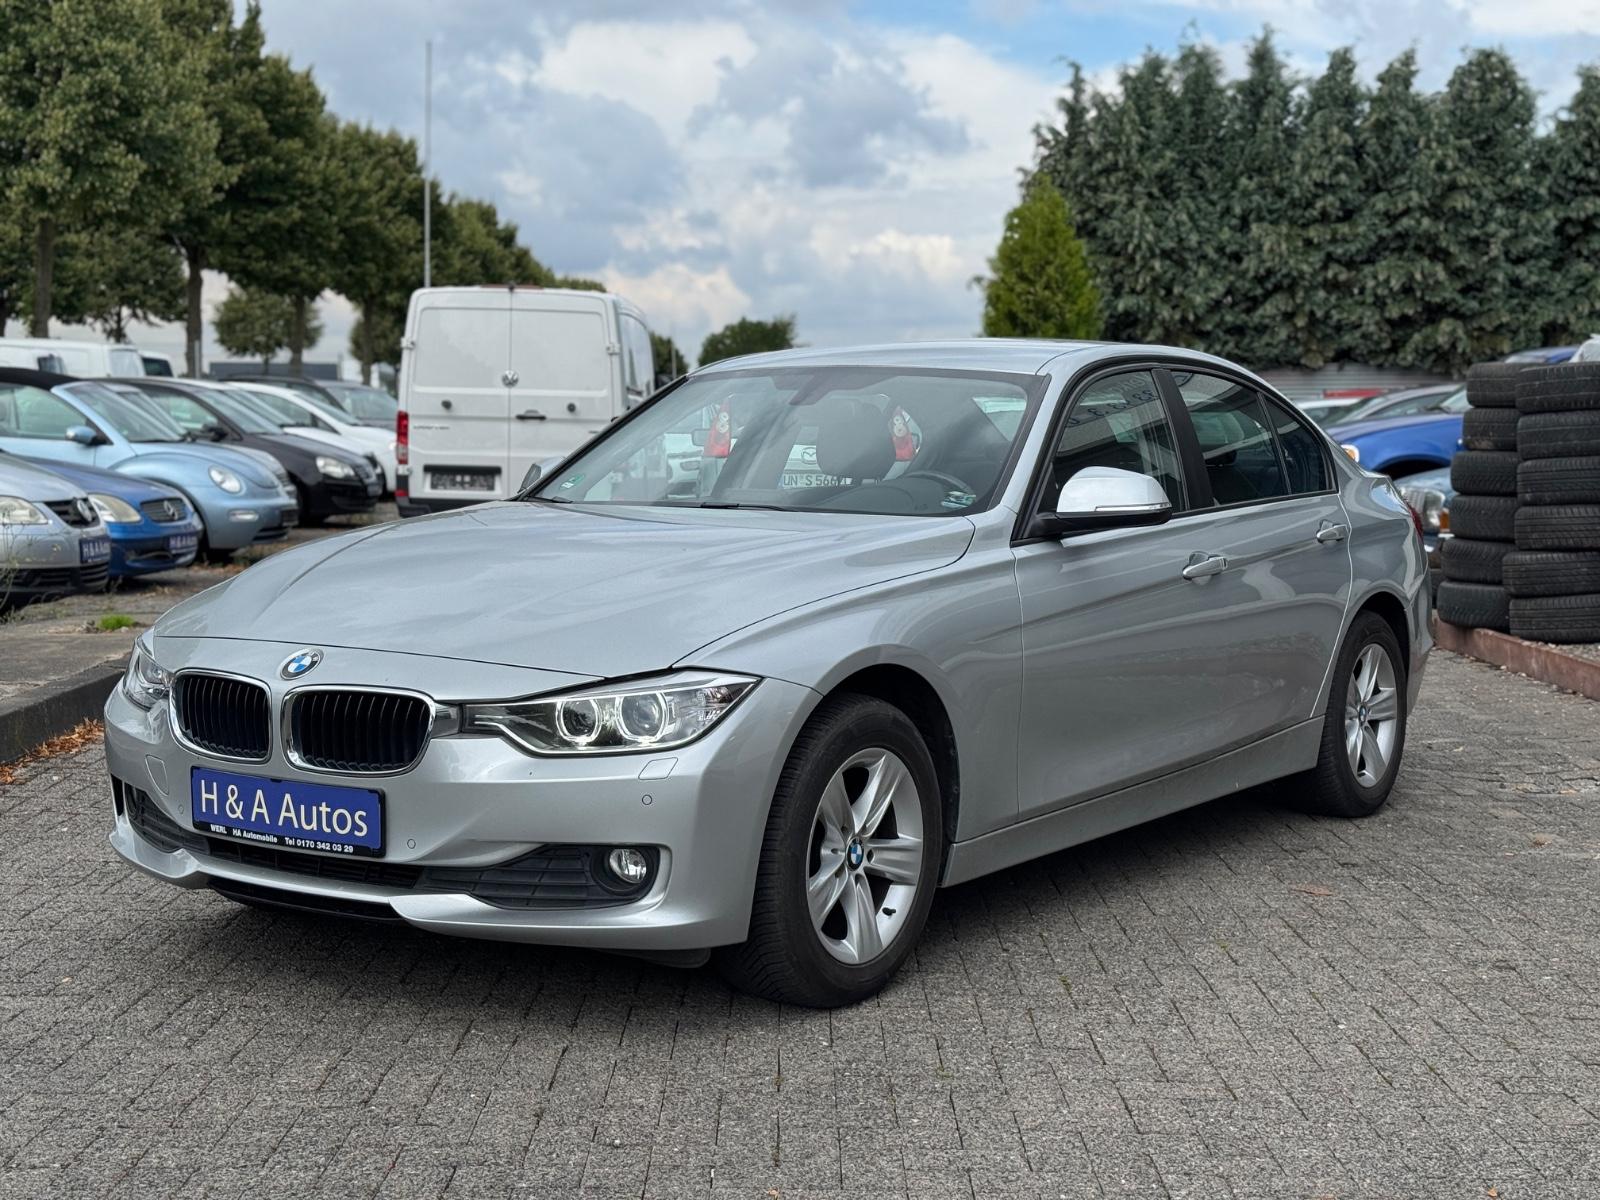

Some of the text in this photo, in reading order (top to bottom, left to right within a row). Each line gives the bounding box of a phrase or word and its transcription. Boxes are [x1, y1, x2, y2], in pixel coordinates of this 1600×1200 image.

[783, 474, 798, 487] UN
[805, 474, 813, 487] S
[201, 779, 368, 837] H & A Autos
[210, 823, 354, 854] WERL HA Automobile Tel 0170 342 03 29
